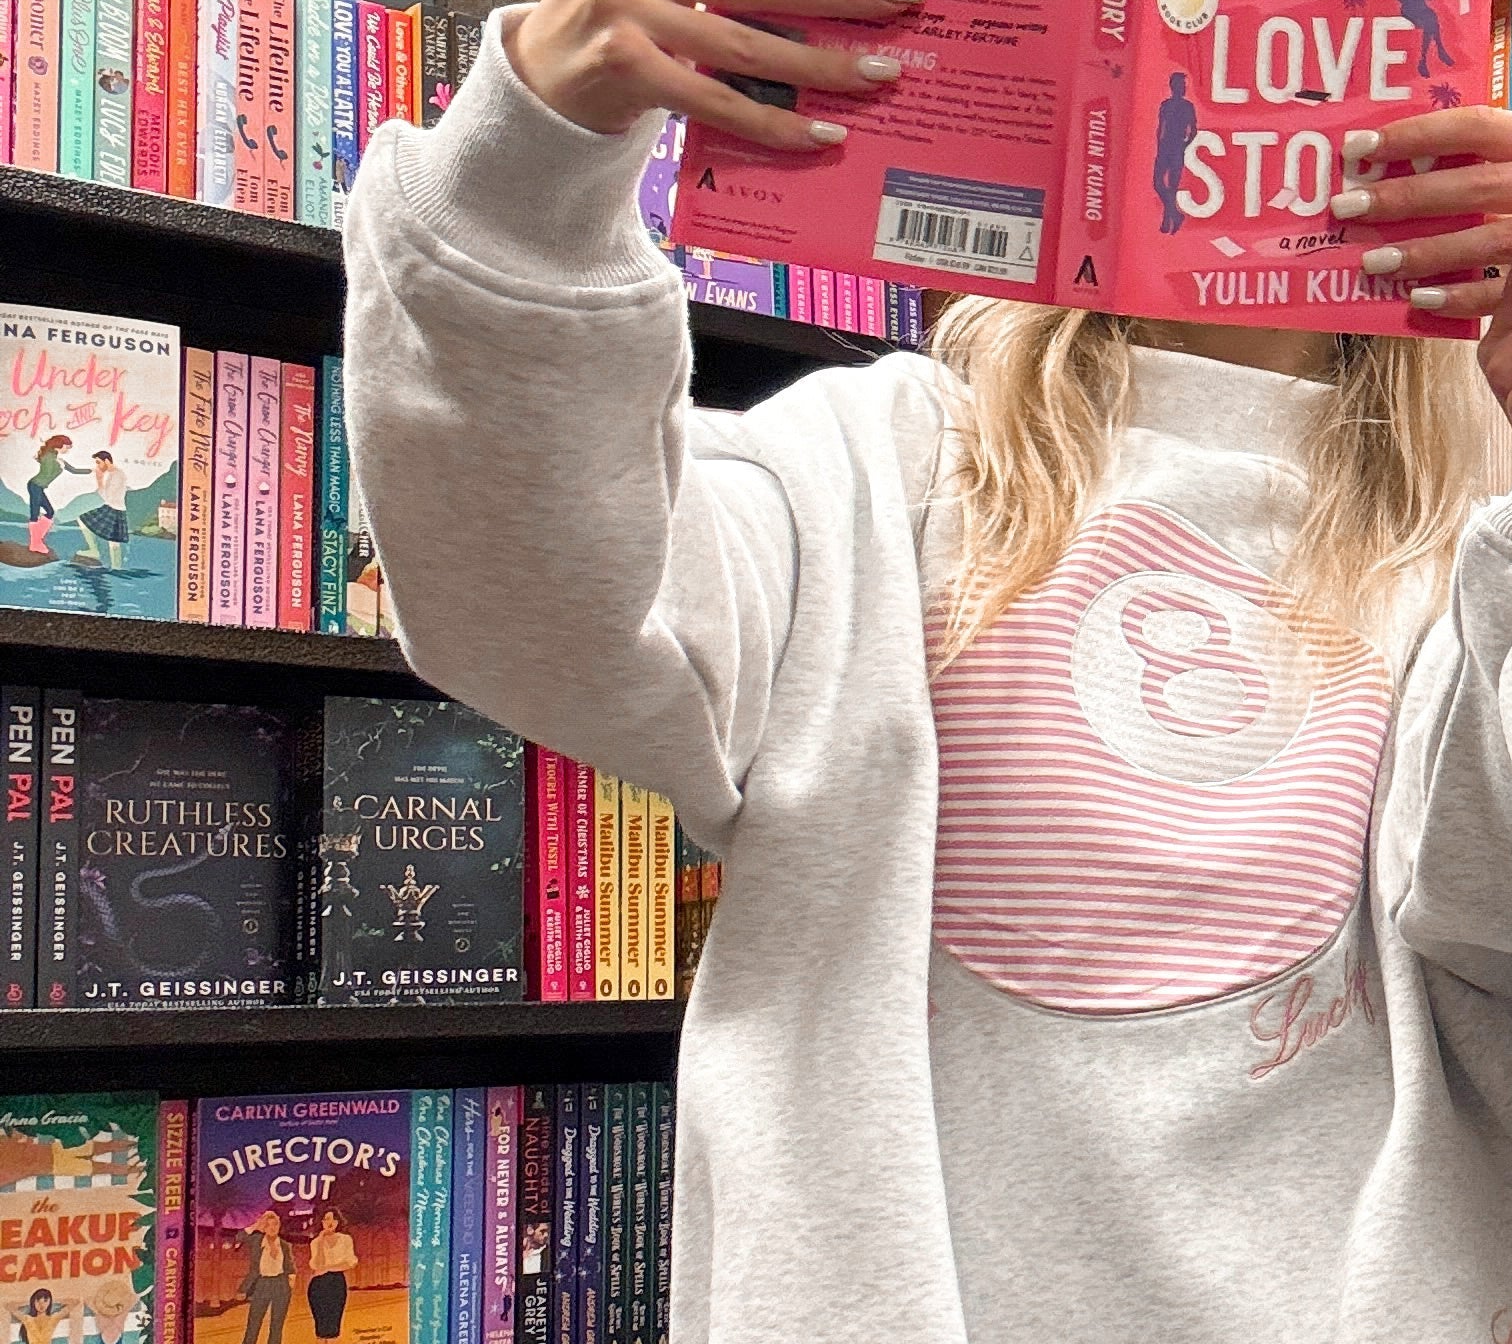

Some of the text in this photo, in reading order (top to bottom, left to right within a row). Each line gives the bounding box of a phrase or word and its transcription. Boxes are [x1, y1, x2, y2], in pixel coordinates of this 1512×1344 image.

[1211, 14, 1416, 104] LOVE
[1085, 109, 1107, 221] YULIN KUANG
[1176, 130, 1439, 219] STO
[725, 184, 783, 204] AVON
[1279, 228, 1348, 250] a novel
[1192, 270, 1288, 305] YULIN
[48, 327, 171, 356] FERGUSON
[11, 348, 129, 396] Under
[109, 392, 173, 458] Key
[188, 485, 199, 602] LANA FERGUSON
[1121, 589, 1270, 739] 8
[7, 706, 32, 822] PEN PAL
[105, 799, 271, 827] RUTHLESS
[354, 794, 502, 821] CARNAL
[87, 831, 287, 858] CREATURES
[374, 825, 486, 852] URGES
[85, 980, 285, 998] J.T. GEISSINGER
[216, 1100, 400, 1122] CARLYN GREENWALD
[165, 1112, 184, 1215] SIZZLE REEL
[208, 1136, 400, 1185] DIRECTOR'S
[269, 1174, 336, 1202] CUT
